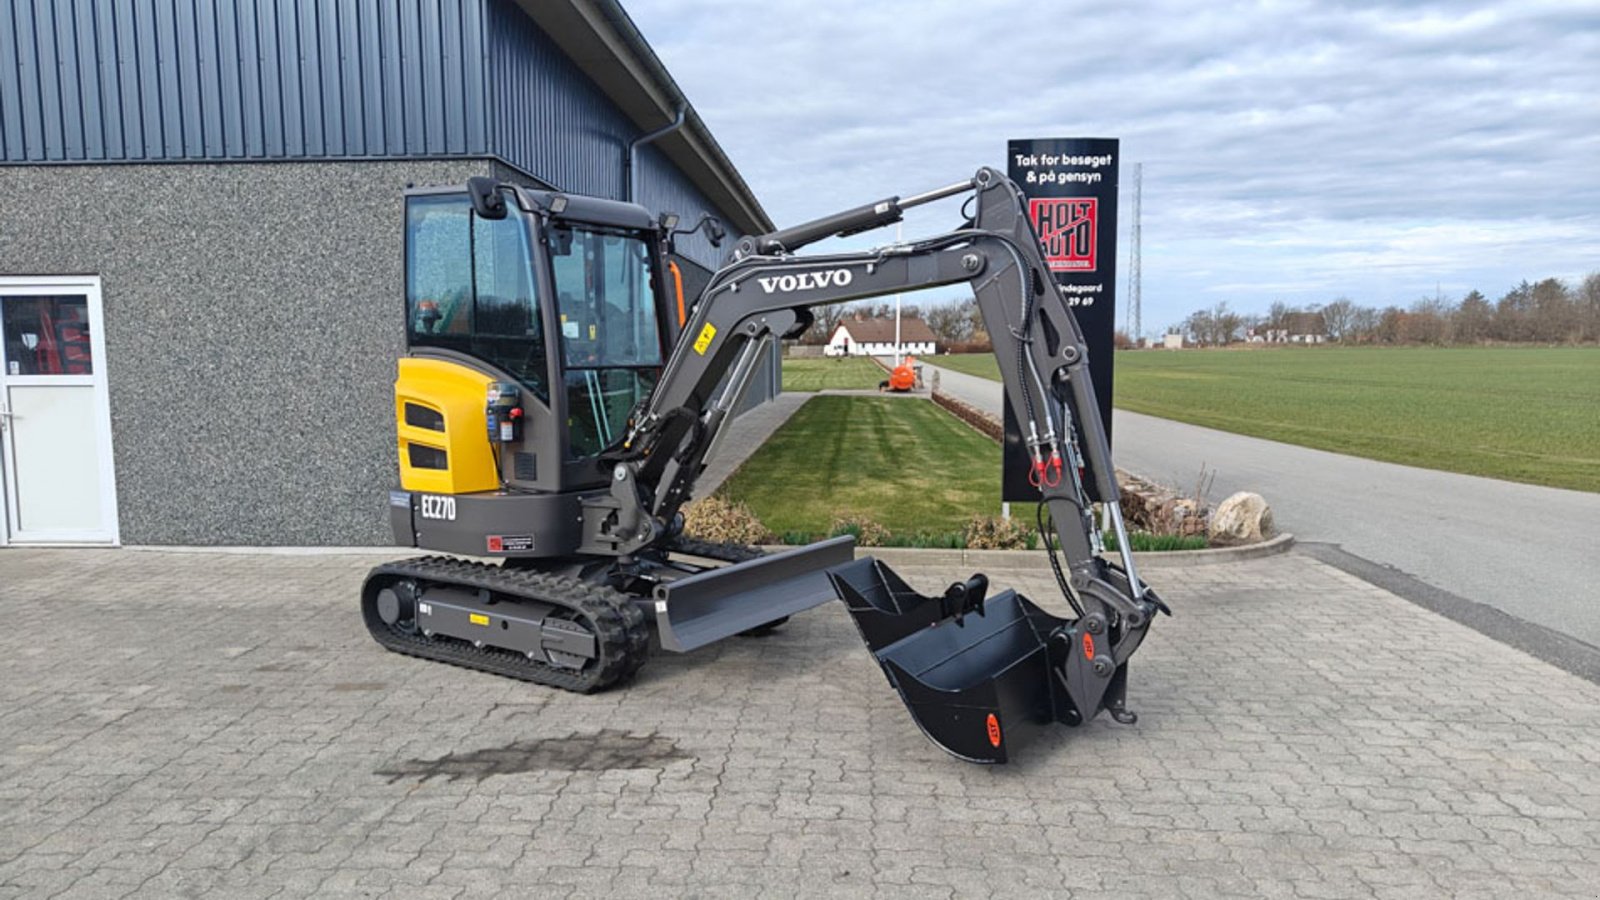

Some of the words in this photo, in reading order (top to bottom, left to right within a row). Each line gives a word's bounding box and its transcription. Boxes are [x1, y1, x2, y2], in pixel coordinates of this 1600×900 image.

[1015, 154, 1038, 167] Tak
[1041, 154, 1061, 167] for
[1062, 153, 1113, 168] besøget
[1026, 171, 1037, 183] &
[1039, 170, 1056, 185] på
[1058, 173, 1102, 185] gensyn
[1038, 203, 1091, 239] HOLT
[757, 269, 852, 293] VOLVO
[1068, 296, 1081, 306] 29
[1082, 296, 1094, 306] 69
[422, 495, 456, 520] EC27D
